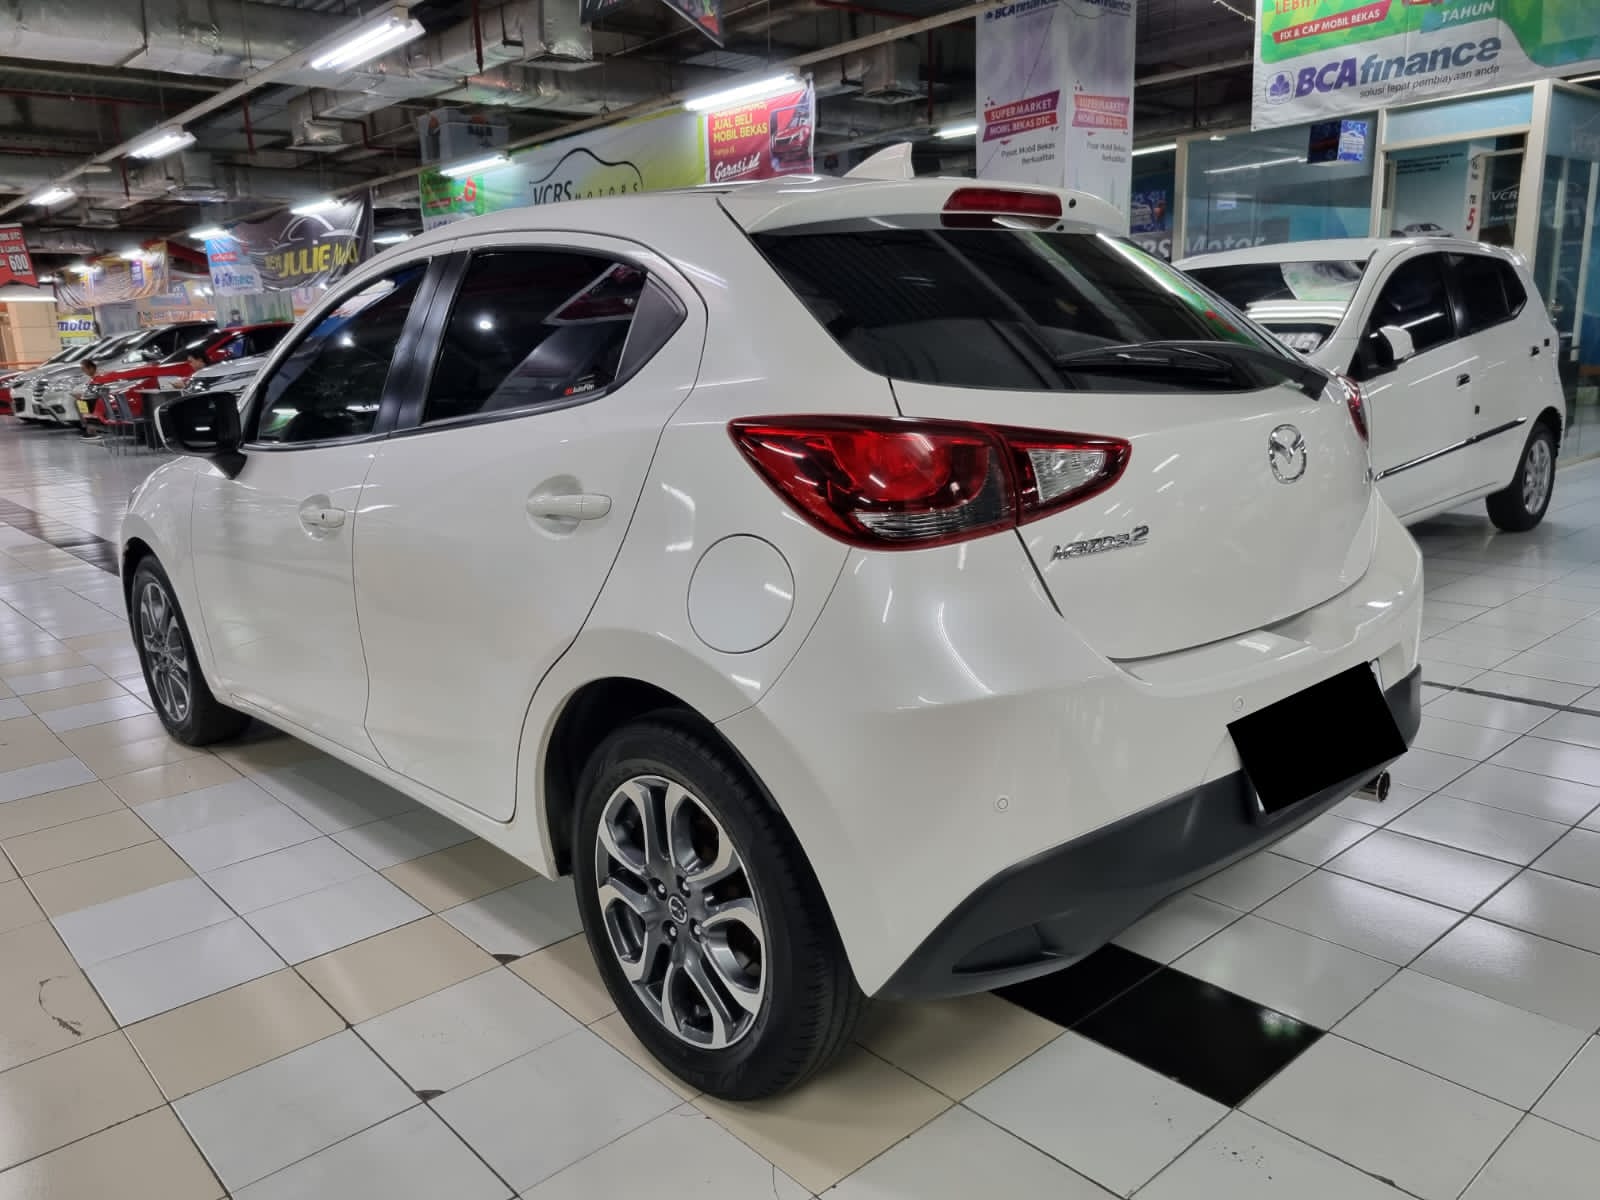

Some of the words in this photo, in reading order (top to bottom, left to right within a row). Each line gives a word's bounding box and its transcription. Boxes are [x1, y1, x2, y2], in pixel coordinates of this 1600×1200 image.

[1280, 31, 1293, 40] FIX
[1302, 24, 1320, 34] CAP
[1321, 17, 1349, 31] MOBIL
[1351, 9, 1381, 23] BEKAS
[1441, 2, 1495, 24] TAHUN
[1295, 57, 1357, 98] BCA
[1360, 37, 1502, 84] finance
[714, 118, 733, 131] JUAL
[735, 113, 753, 126] BELI
[990, 99, 1052, 121] SUPERMARKET
[713, 129, 738, 143] MOBIL
[740, 123, 768, 137] BEKAS
[533, 180, 573, 206] VCRS
[278, 243, 331, 278] JULIE
